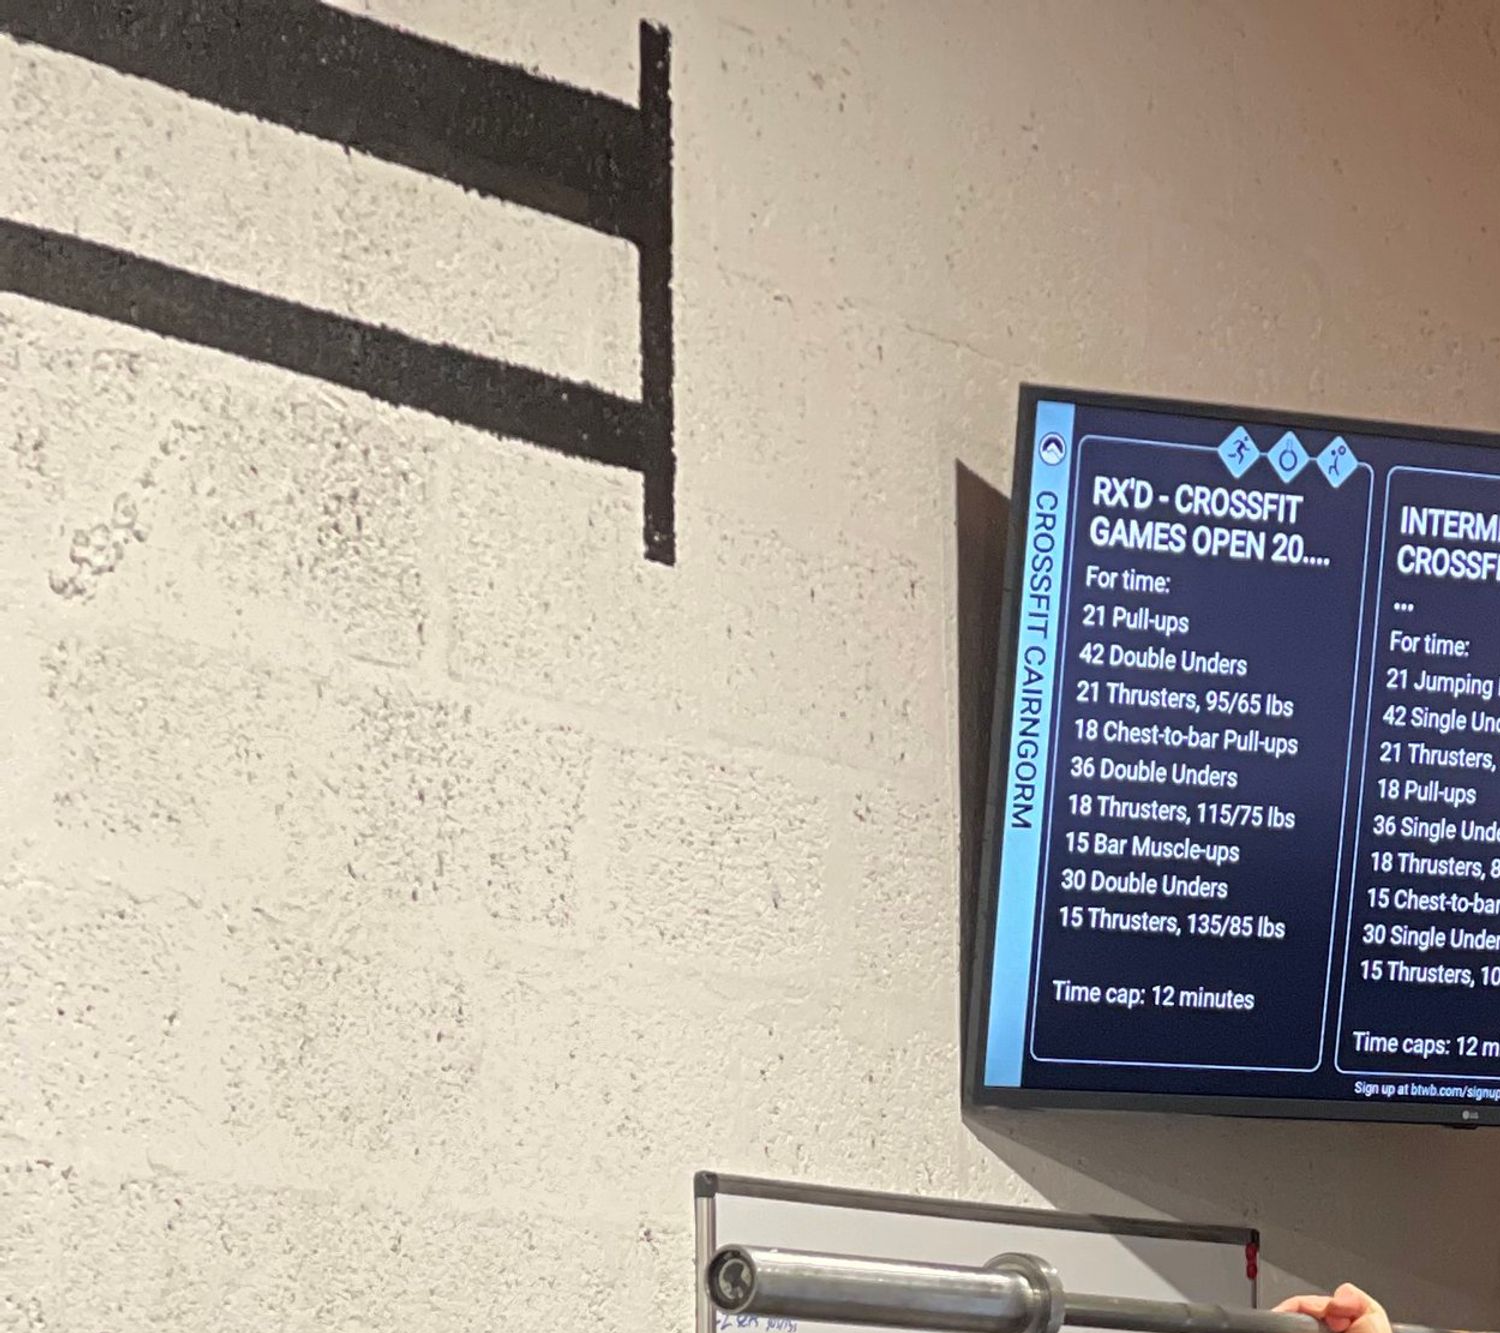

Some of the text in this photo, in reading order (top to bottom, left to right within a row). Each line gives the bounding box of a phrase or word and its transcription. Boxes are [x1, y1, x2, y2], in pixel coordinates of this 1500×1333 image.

[1093, 476, 1304, 524] RX'D CROSSFIT
[1089, 515, 1186, 553] GAMES
[1192, 526, 1265, 561] OPEN
[1085, 565, 1170, 593] For time:
[1082, 603, 1189, 636] 21 Pull-ups
[1078, 642, 1247, 676] 42 Double Unders
[1389, 630, 1469, 657] For time:
[1011, 490, 1058, 829] CROSSFIT CAIRNGORM
[1076, 680, 1294, 717] 21 Thrusters, 95/65 lbs
[1386, 667, 1407, 689] 21
[1413, 670, 1494, 700] Jumping
[1382, 704, 1406, 726] 42
[1410, 707, 1467, 734] Single
[1075, 718, 1298, 759] 18 Chest-to-bar Pull-ups
[1070, 755, 1237, 788] 36 Double Unders
[1379, 741, 1401, 762] 21
[1408, 743, 1496, 772] Thrusters,
[1377, 778, 1476, 808] 18 Pull-ups
[1068, 794, 1295, 829] 18 Thrusters, 115/75 lbs
[1373, 814, 1396, 836] 36
[1400, 816, 1457, 843] Single
[1065, 831, 1239, 866] 15 Bar Muscle-ups
[1371, 851, 1393, 872] 18
[1397, 852, 1485, 881] Thrusters,
[1061, 868, 1228, 899] 30 Double Unders
[1367, 887, 1390, 908] 15
[1059, 906, 1285, 939] 15 Thrusters, 135/85 lbs
[1362, 923, 1386, 944] 30
[1390, 925, 1446, 951] Single
[1360, 959, 1383, 980] 15
[1387, 960, 1475, 988] Thrusters,
[1052, 980, 1255, 1010] Time cap: 12 minutes
[1352, 1031, 1399, 1053] Time
[1402, 1037, 1451, 1059] caps:
[1456, 1036, 1478, 1056] 12
[1354, 1081, 1379, 1097] Sign
[1381, 1084, 1395, 1097] up
[1396, 1084, 1409, 1095] at
